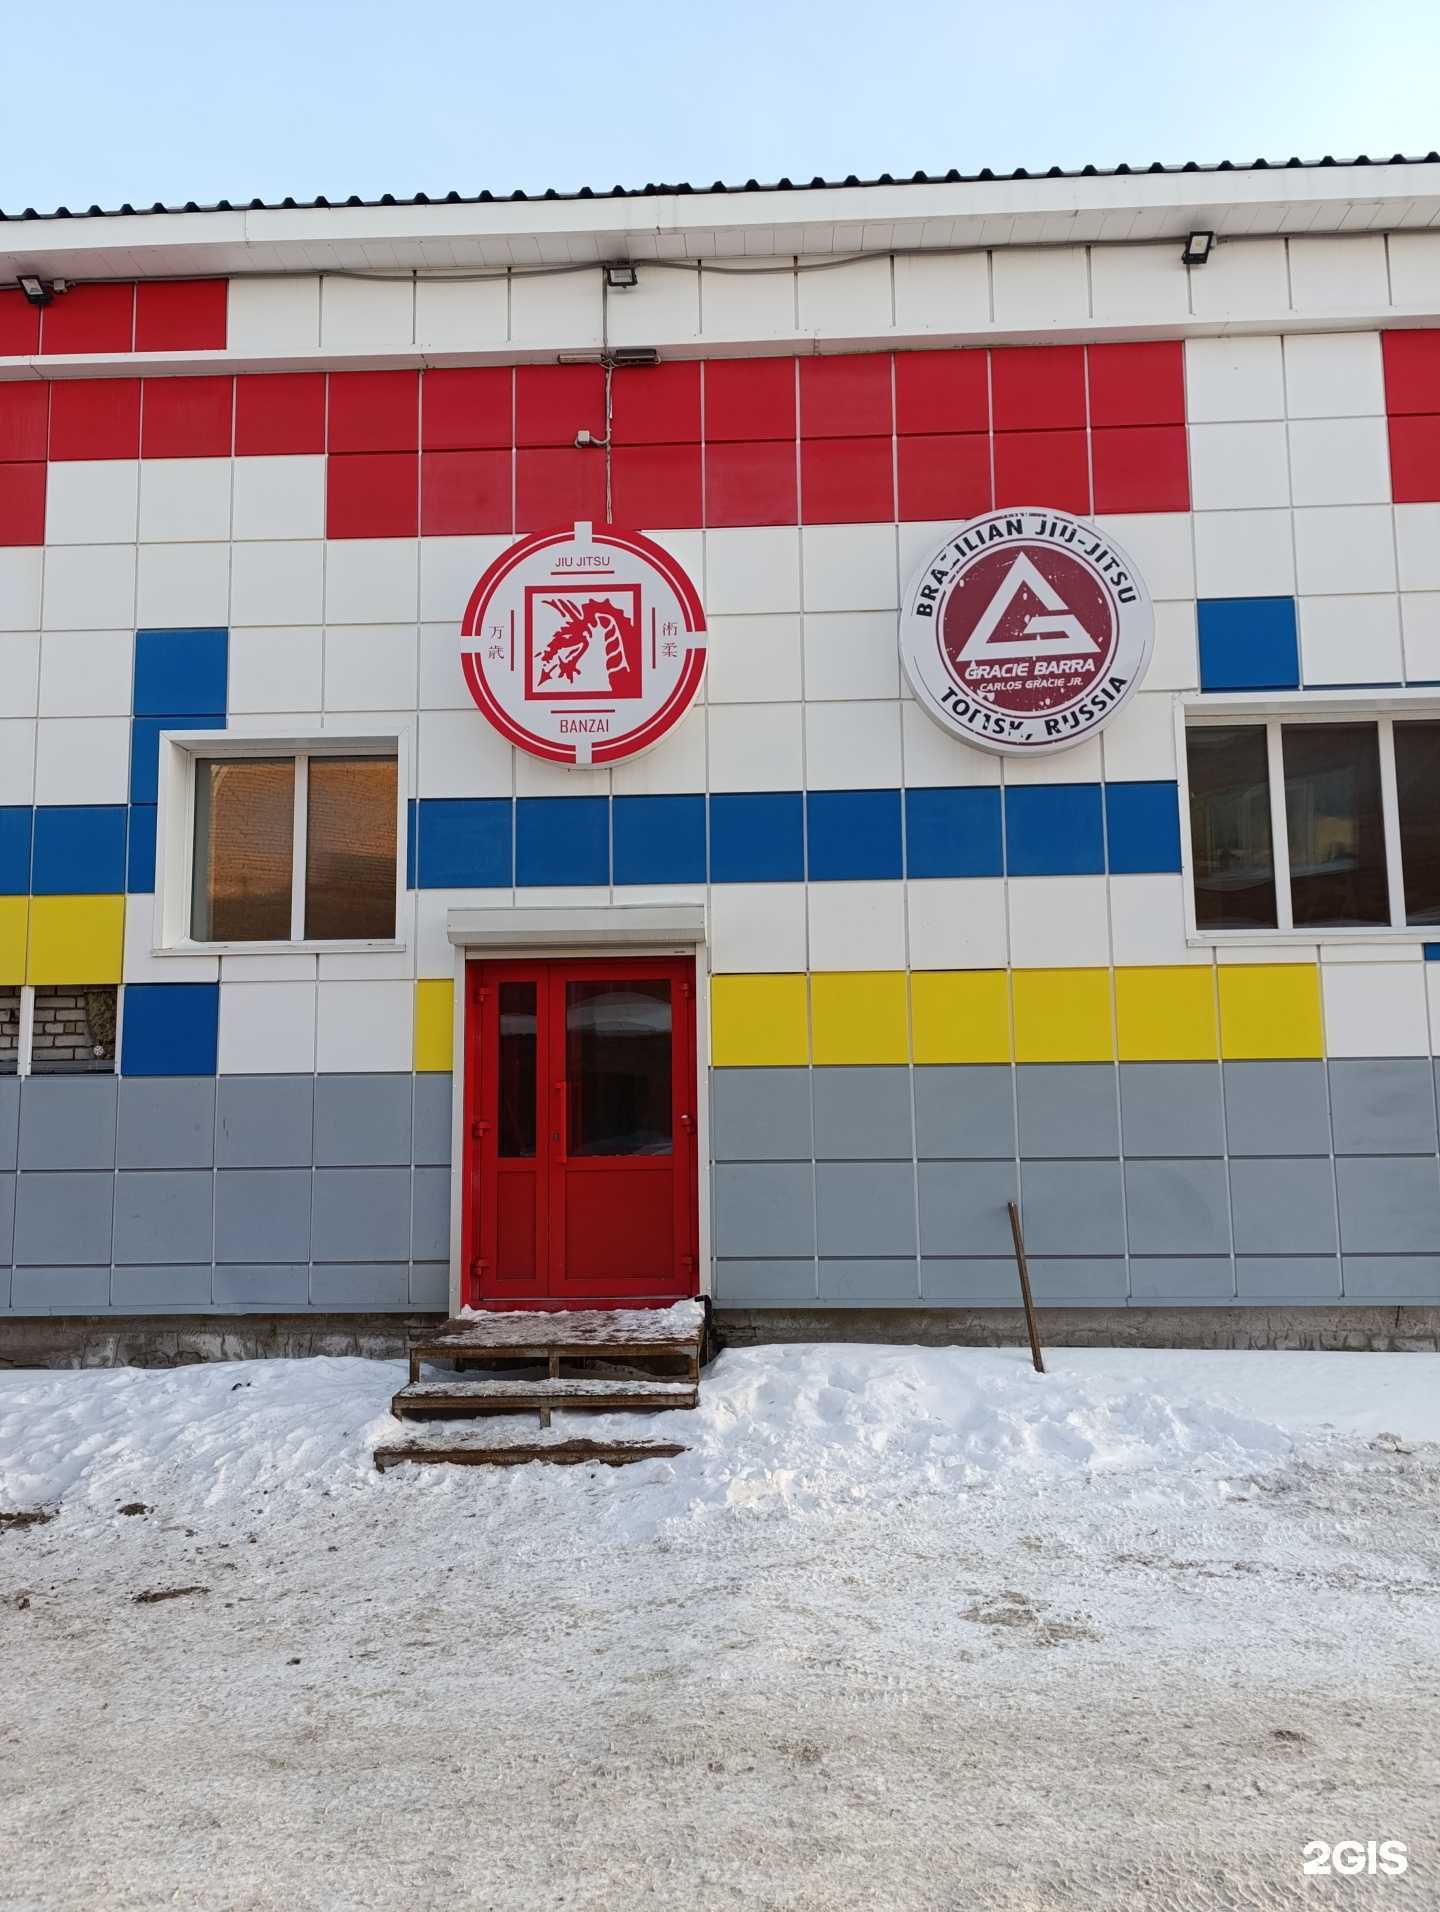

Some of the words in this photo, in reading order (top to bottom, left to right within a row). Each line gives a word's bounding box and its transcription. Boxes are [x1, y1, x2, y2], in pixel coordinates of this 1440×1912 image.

[554, 556, 573, 568] JIU
[576, 555, 611, 567] JITSU
[1034, 519, 1137, 604] JIU-JITSU
[964, 662, 1030, 680] GRACIE
[1034, 658, 1096, 676] BARRA
[979, 680, 1023, 692] CARLOS
[1025, 678, 1065, 689] GRACIE
[1066, 677, 1084, 687] JR.
[1044, 676, 1128, 736] RUSSIA
[560, 718, 609, 733] BANZAI
